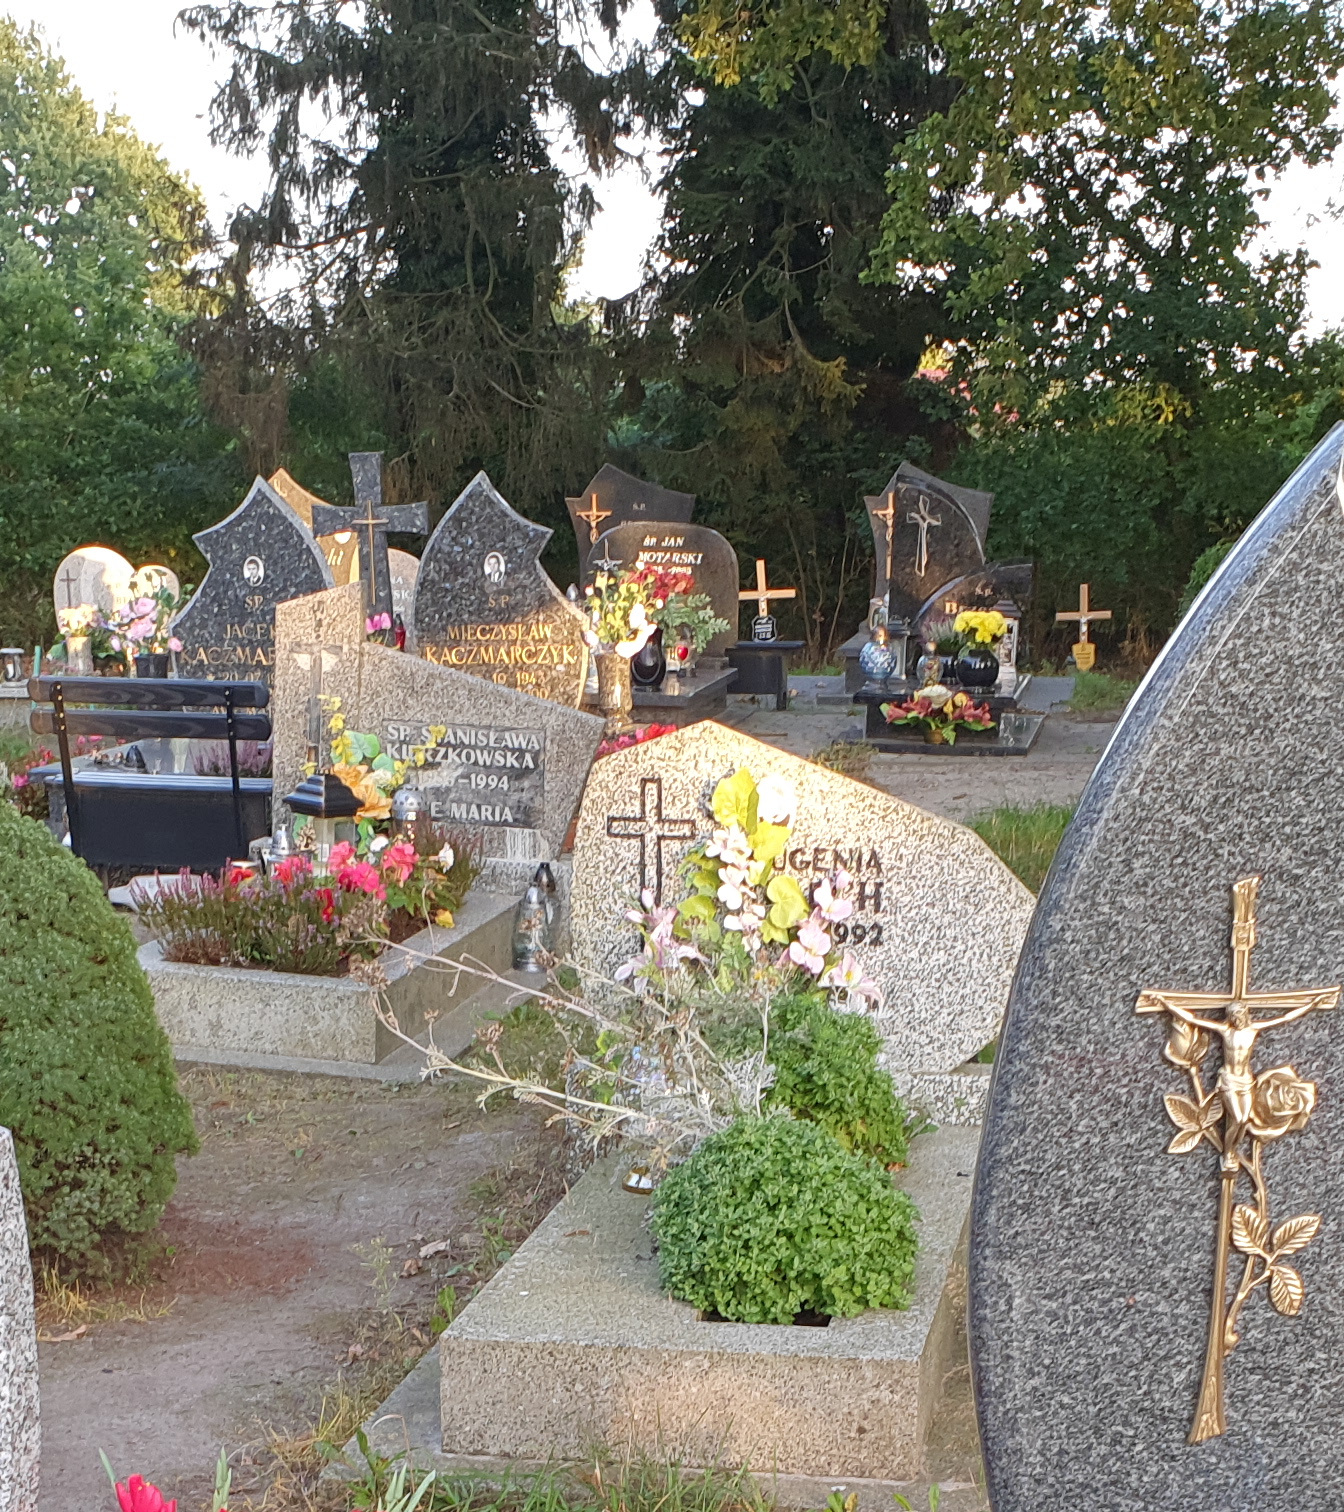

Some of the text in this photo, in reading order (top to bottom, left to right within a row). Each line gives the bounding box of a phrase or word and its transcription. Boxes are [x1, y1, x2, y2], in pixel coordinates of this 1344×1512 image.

[661, 536, 685, 547] JAN
[425, 645, 578, 666] KACZMARCZYK
[420, 725, 541, 751] SANISŁAWA
[450, 802, 514, 823] MARIA
[773, 847, 883, 873] UGENIA
